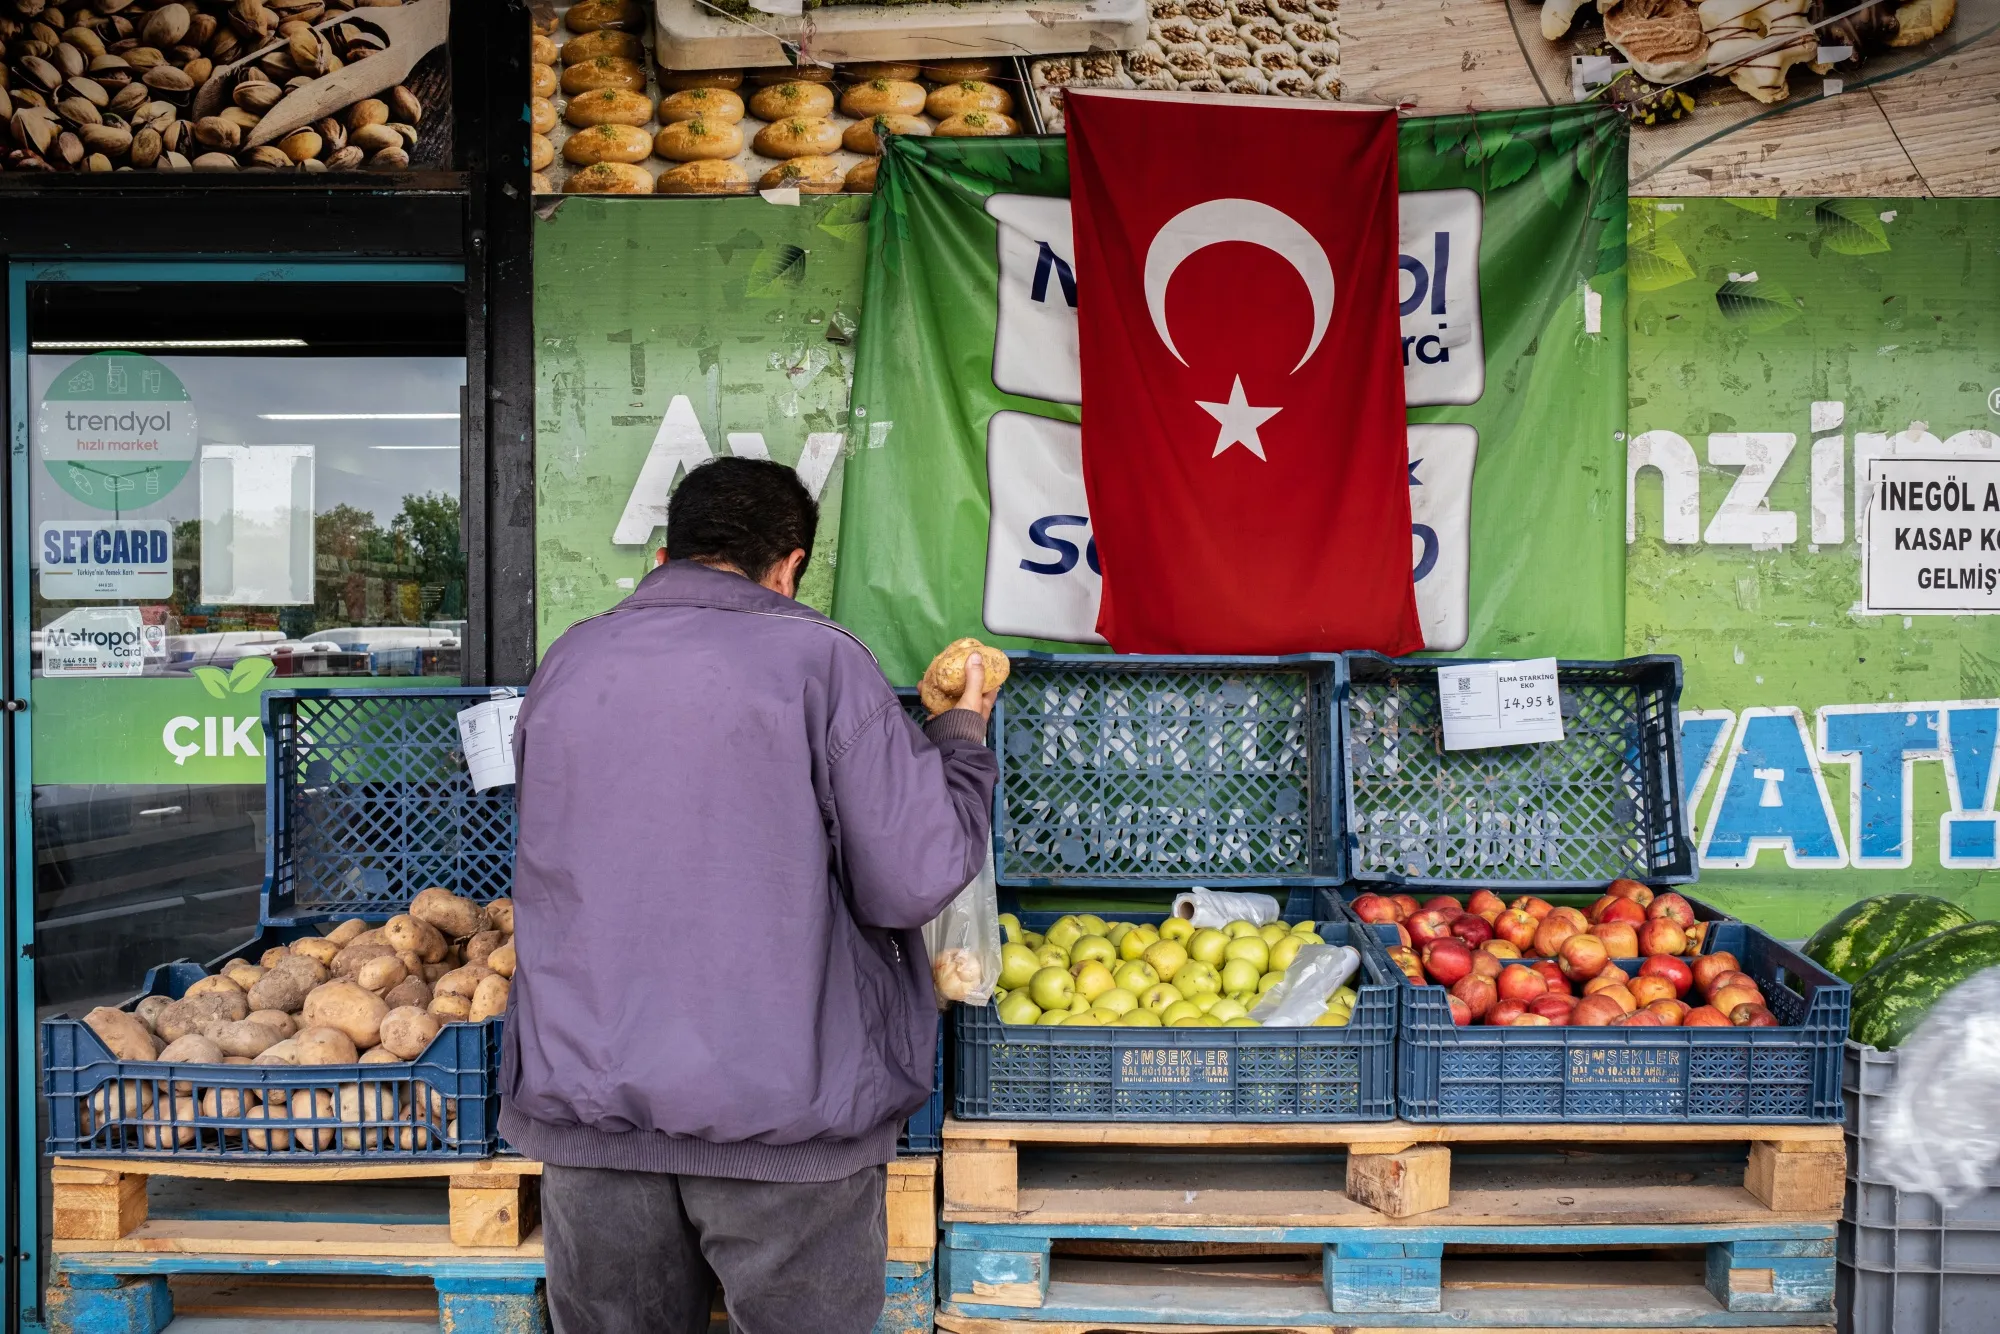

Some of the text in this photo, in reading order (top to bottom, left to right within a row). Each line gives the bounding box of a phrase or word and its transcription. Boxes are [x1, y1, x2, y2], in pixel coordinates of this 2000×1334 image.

[65, 411, 171, 435] trendyol
[77, 439, 159, 451] hızlı market
[1880, 474, 1976, 512] İNEGÖL
[44, 529, 168, 564] SETCARD
[1895, 527, 1973, 551] KASAP
[1917, 563, 2000, 595] GELMİŞ
[47, 627, 141, 650] Metropol
[113, 647, 141, 657] Card
[1519, 674, 1555, 682] STARKİNG
[1504, 696, 1542, 710] 14,95
[162, 715, 266, 766] ÇIK
[1121, 1066, 1139, 1076] HAL
